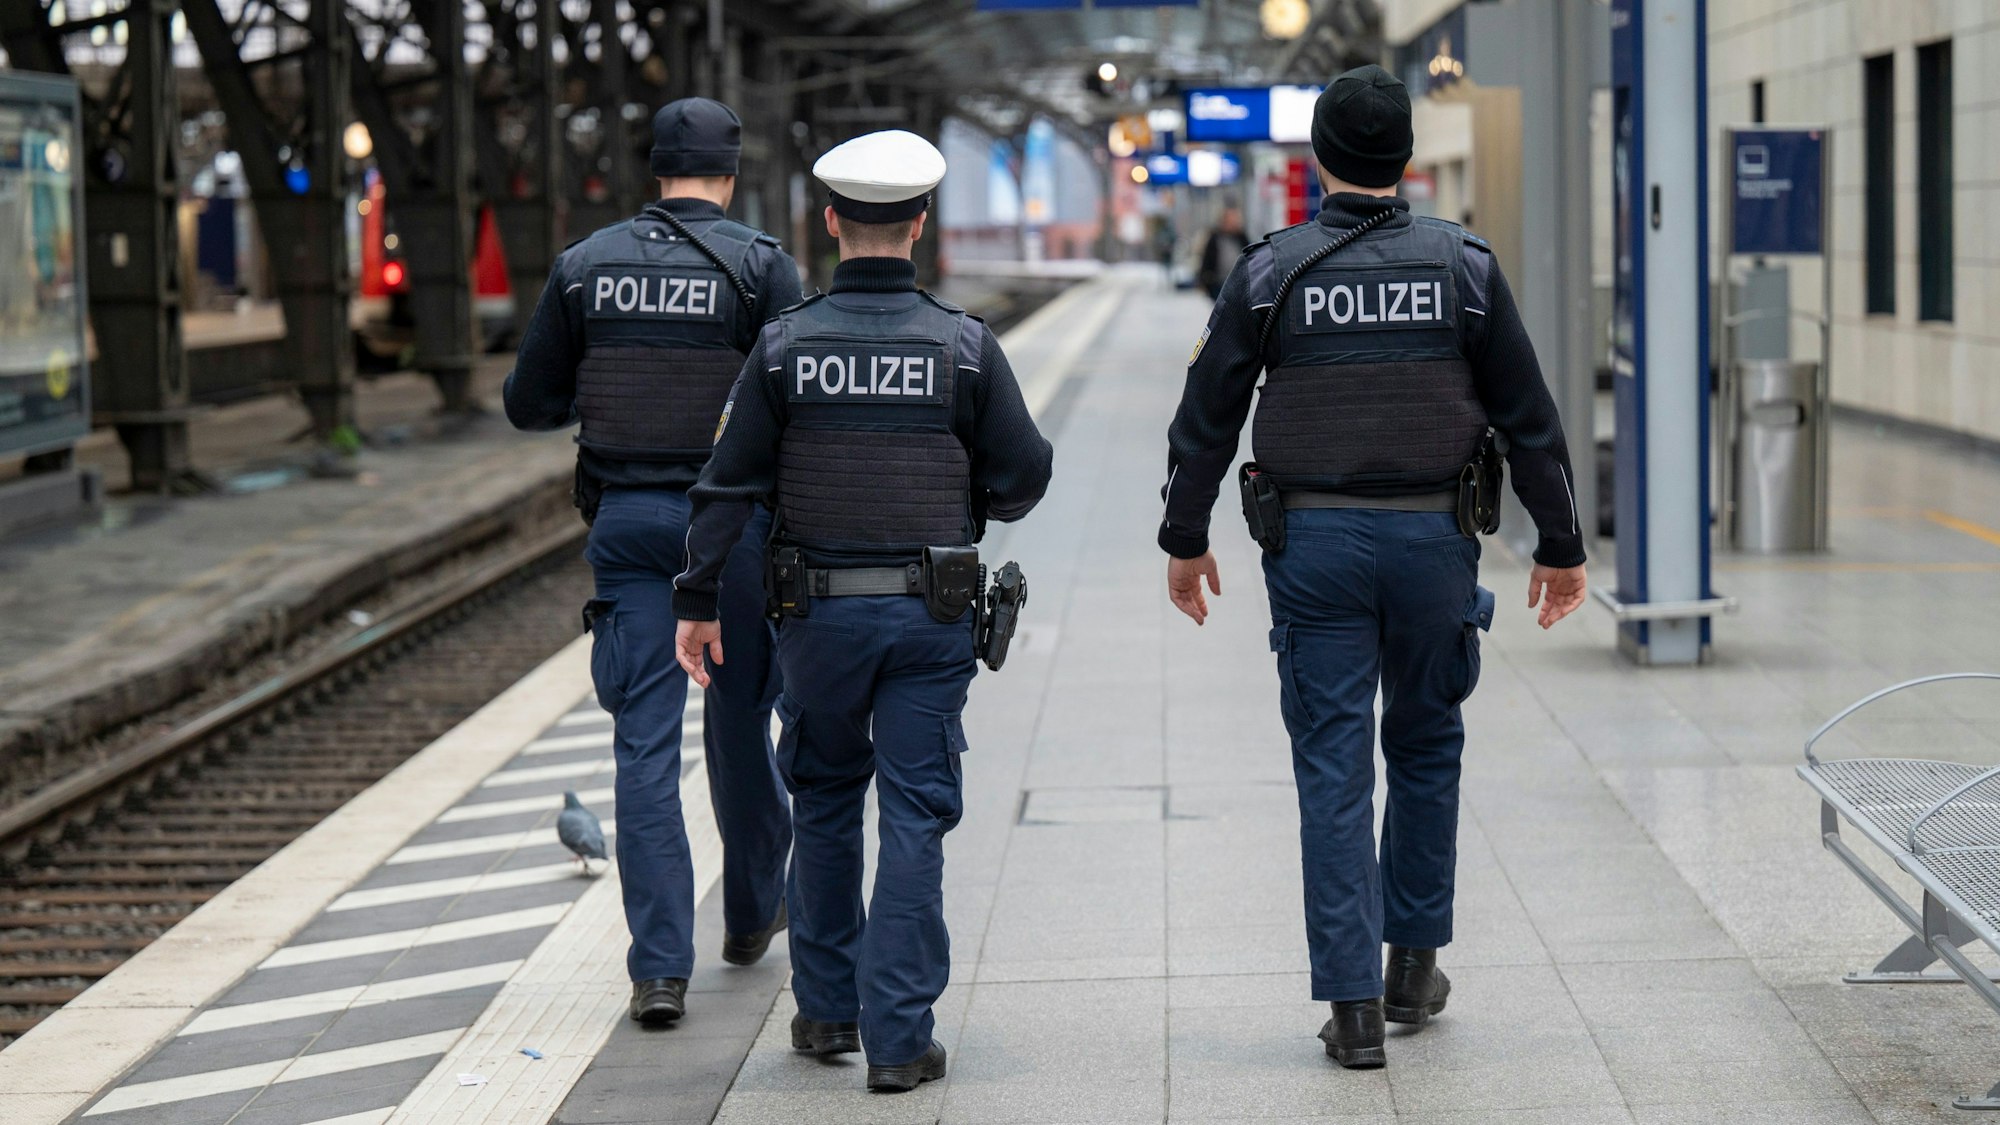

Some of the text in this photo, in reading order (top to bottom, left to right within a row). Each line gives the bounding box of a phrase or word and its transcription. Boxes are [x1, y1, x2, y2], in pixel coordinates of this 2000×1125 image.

[594, 275, 718, 315] POLIZEI
[1304, 281, 1442, 326] POLIZEI
[796, 355, 935, 396] POLIZEI
